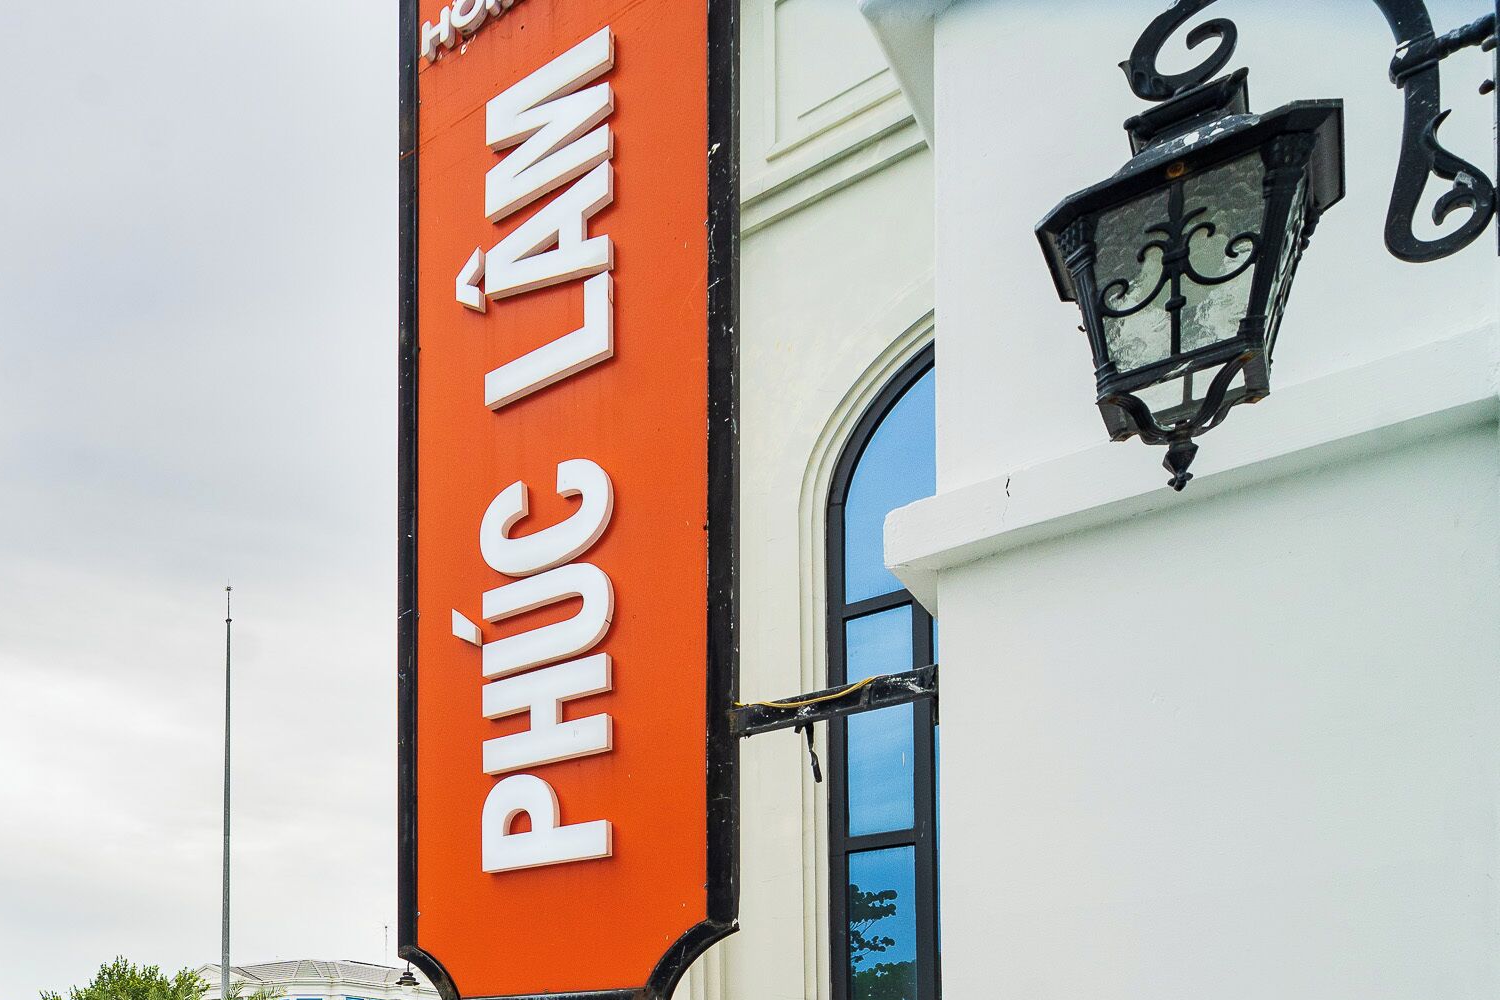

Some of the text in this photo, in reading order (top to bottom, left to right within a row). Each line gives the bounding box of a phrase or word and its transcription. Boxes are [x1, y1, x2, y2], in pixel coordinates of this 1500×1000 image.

[420, 0, 515, 63] HO
[451, 25, 615, 874] PHÚC LÂM
